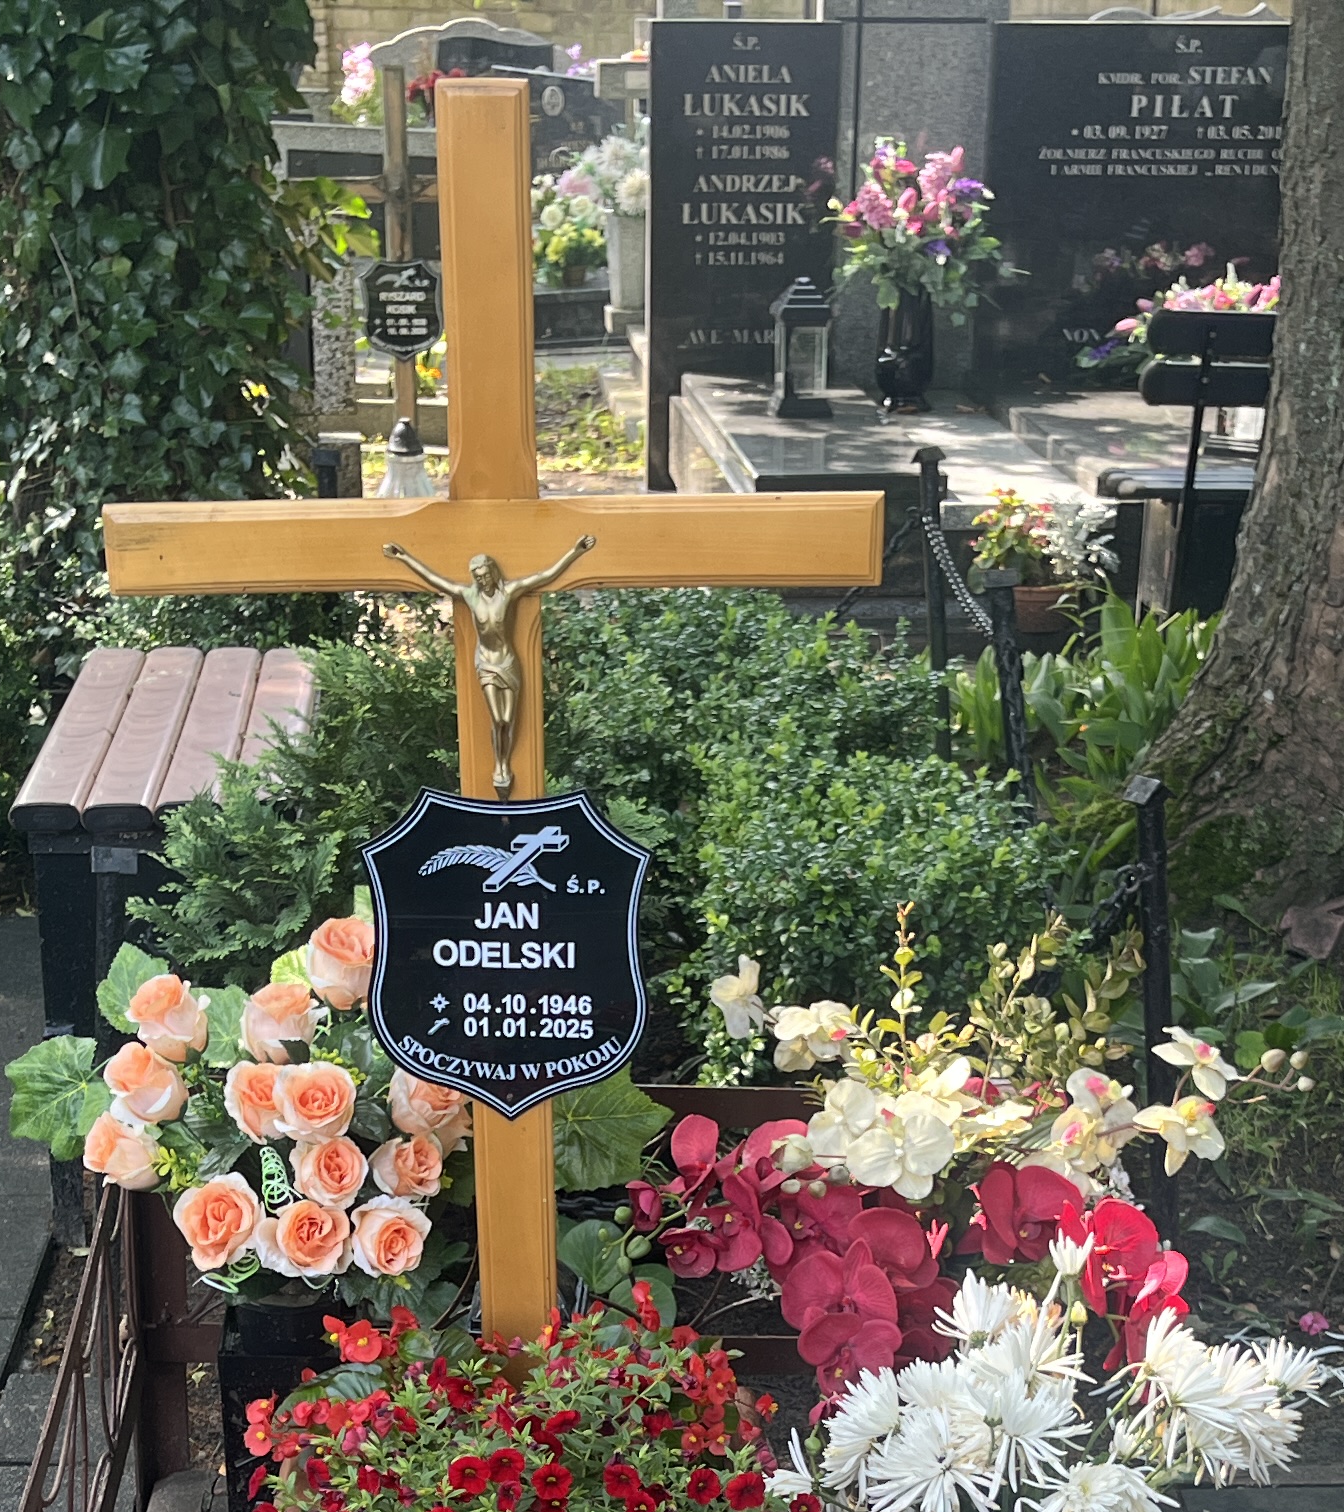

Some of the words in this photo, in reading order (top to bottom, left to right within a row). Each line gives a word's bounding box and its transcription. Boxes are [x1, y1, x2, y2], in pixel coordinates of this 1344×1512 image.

[705, 64, 792, 84] ANIELA
[1187, 66, 1274, 86] STEFAN
[693, 174, 797, 193] ANDRZEJ
[732, 328, 777, 345] MAR
[566, 874, 606, 895] Ś.P.
[474, 902, 540, 930] JAN
[432, 940, 576, 969] ODELSKI
[397, 1035, 517, 1081] SPOCZYWAJ
[520, 1063, 541, 1080] W
[544, 1035, 624, 1079] POKOJU
